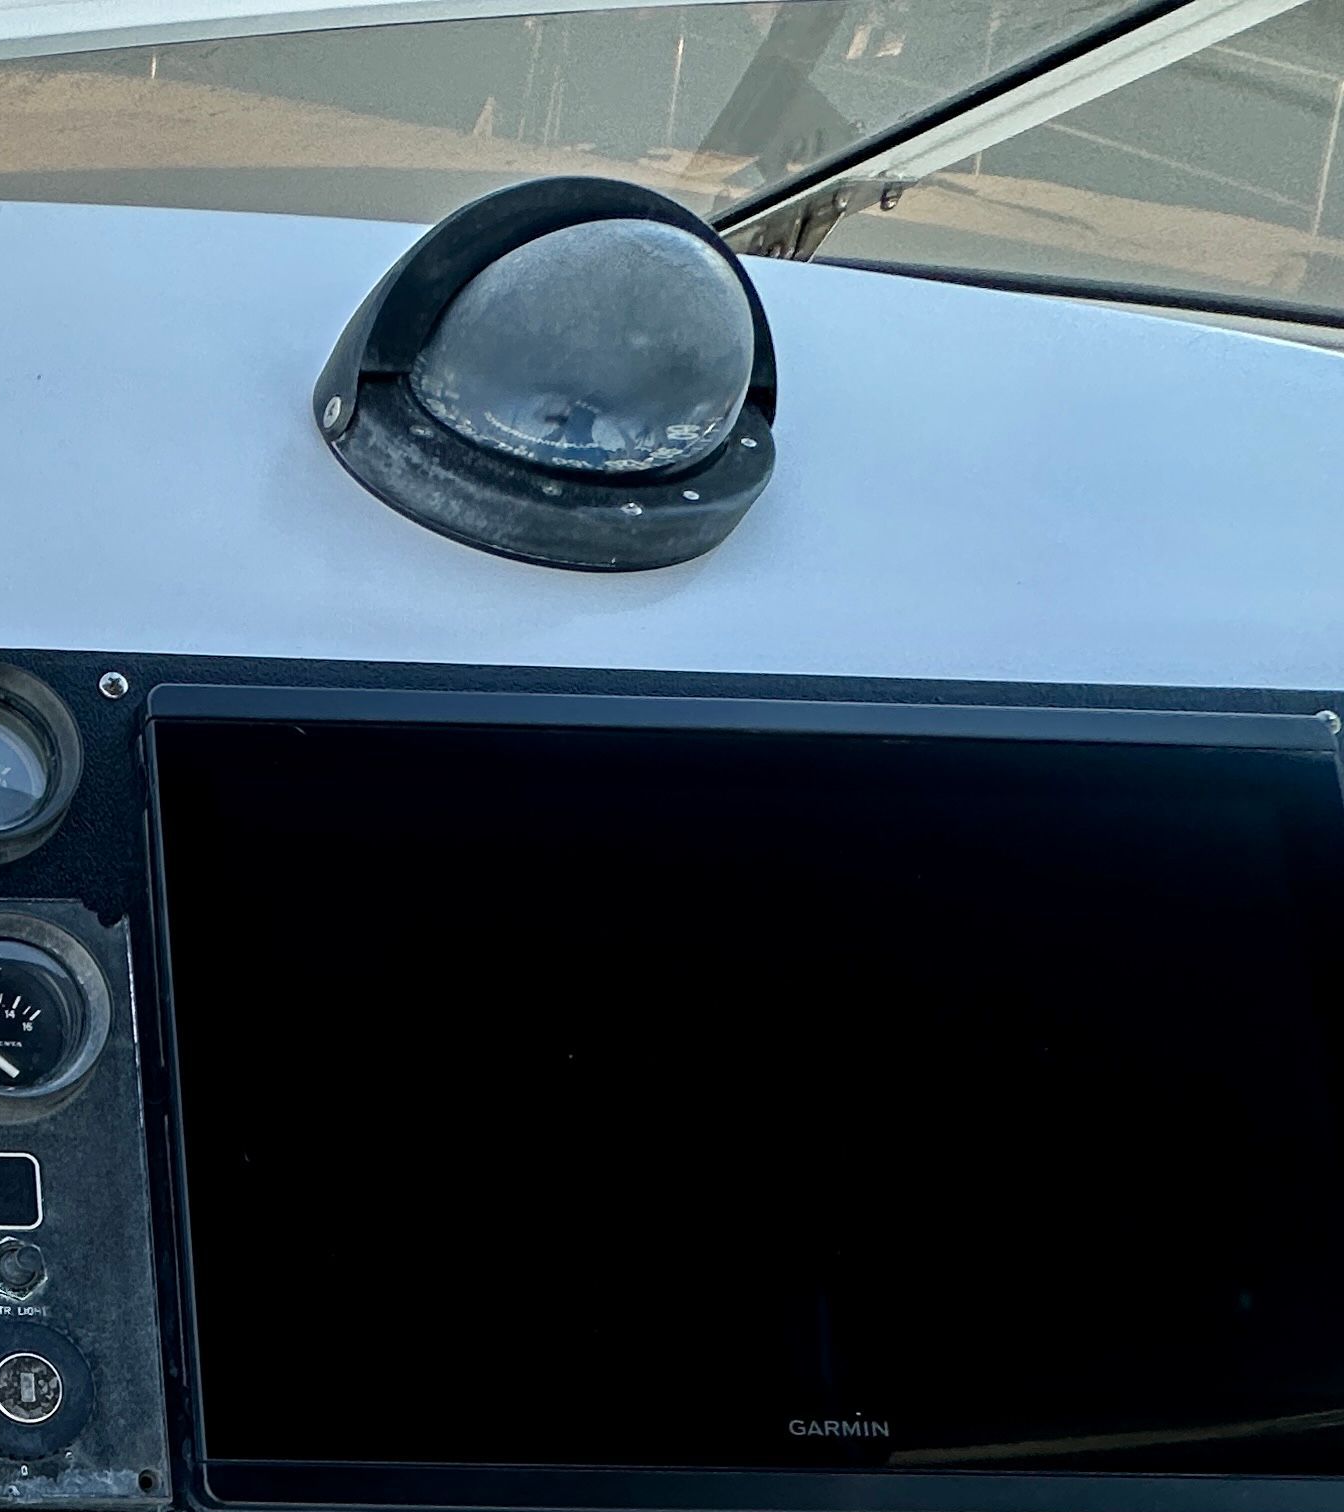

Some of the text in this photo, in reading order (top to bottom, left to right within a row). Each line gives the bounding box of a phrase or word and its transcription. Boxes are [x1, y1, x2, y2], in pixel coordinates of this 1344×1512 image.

[5, 1010, 16, 1019] 14
[22, 1022, 33, 1032] 16
[789, 1419, 889, 1437] GARMIN
